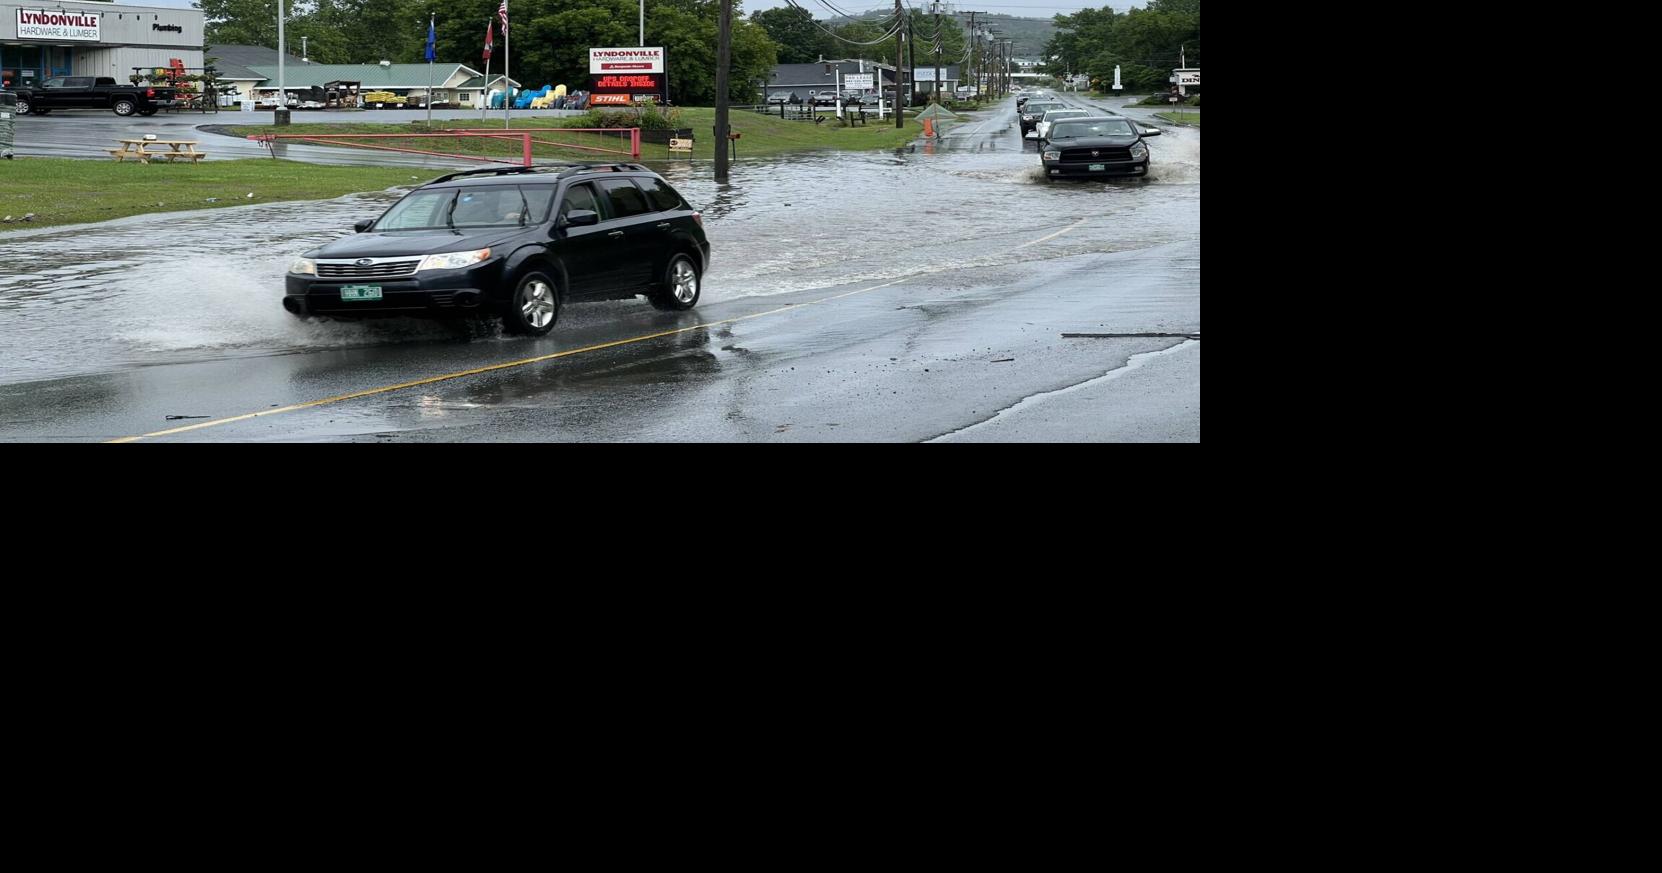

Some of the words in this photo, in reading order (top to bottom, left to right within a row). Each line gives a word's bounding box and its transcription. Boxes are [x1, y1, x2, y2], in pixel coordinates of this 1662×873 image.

[20, 11, 97, 27] LYNDONVILLE
[20, 27, 62, 37] HARDWARE
[63, 29, 68, 37] &
[69, 29, 98, 38] LUMBER
[152, 23, 183, 33] Plumbing
